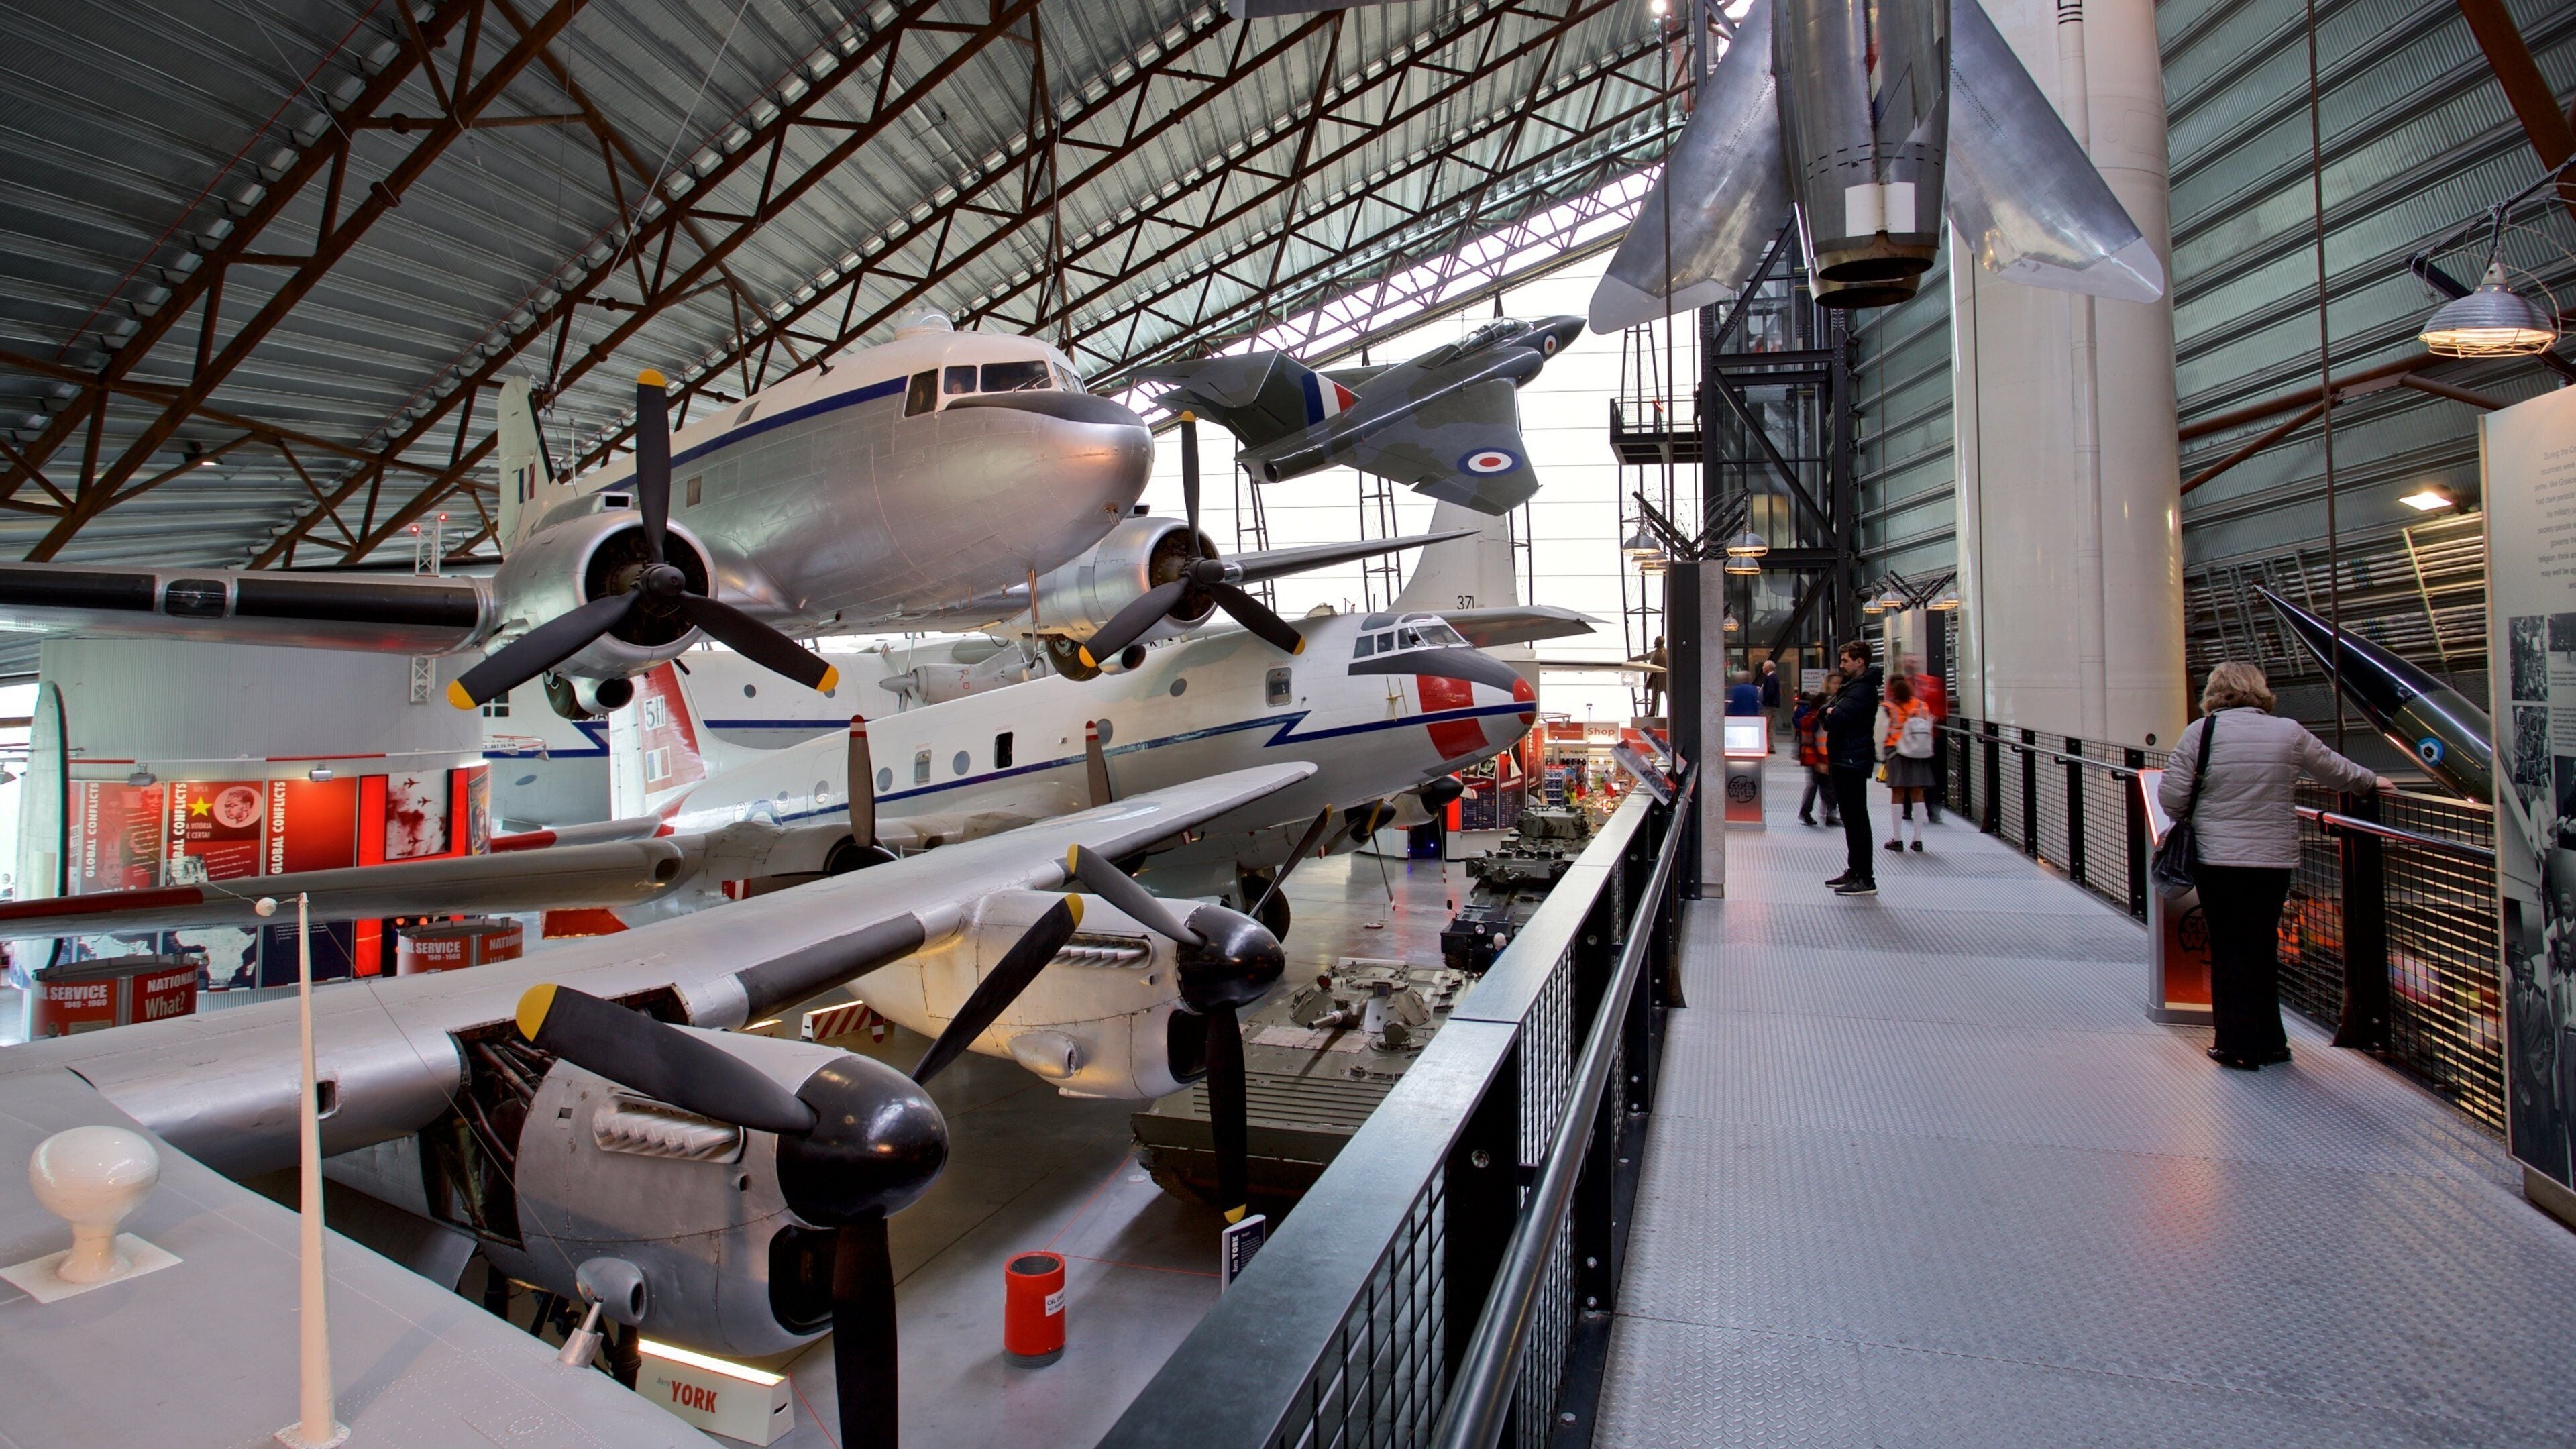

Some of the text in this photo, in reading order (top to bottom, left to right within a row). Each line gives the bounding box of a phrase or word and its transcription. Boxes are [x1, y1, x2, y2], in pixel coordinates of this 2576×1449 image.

[1457, 595, 1474, 610] 371
[645, 698, 665, 727] 511
[1587, 727, 1615, 737] Shop
[172, 782, 187, 835] CONFLICTS
[85, 782, 99, 878] GLOBAL CONFLICTS
[270, 781, 286, 875] GLOBAL CONFLICTS
[415, 941, 461, 954] SERVICE
[50, 985, 108, 1000] SERVICE
[144, 990, 186, 1020] What?
[672, 1380, 718, 1413] YORK
